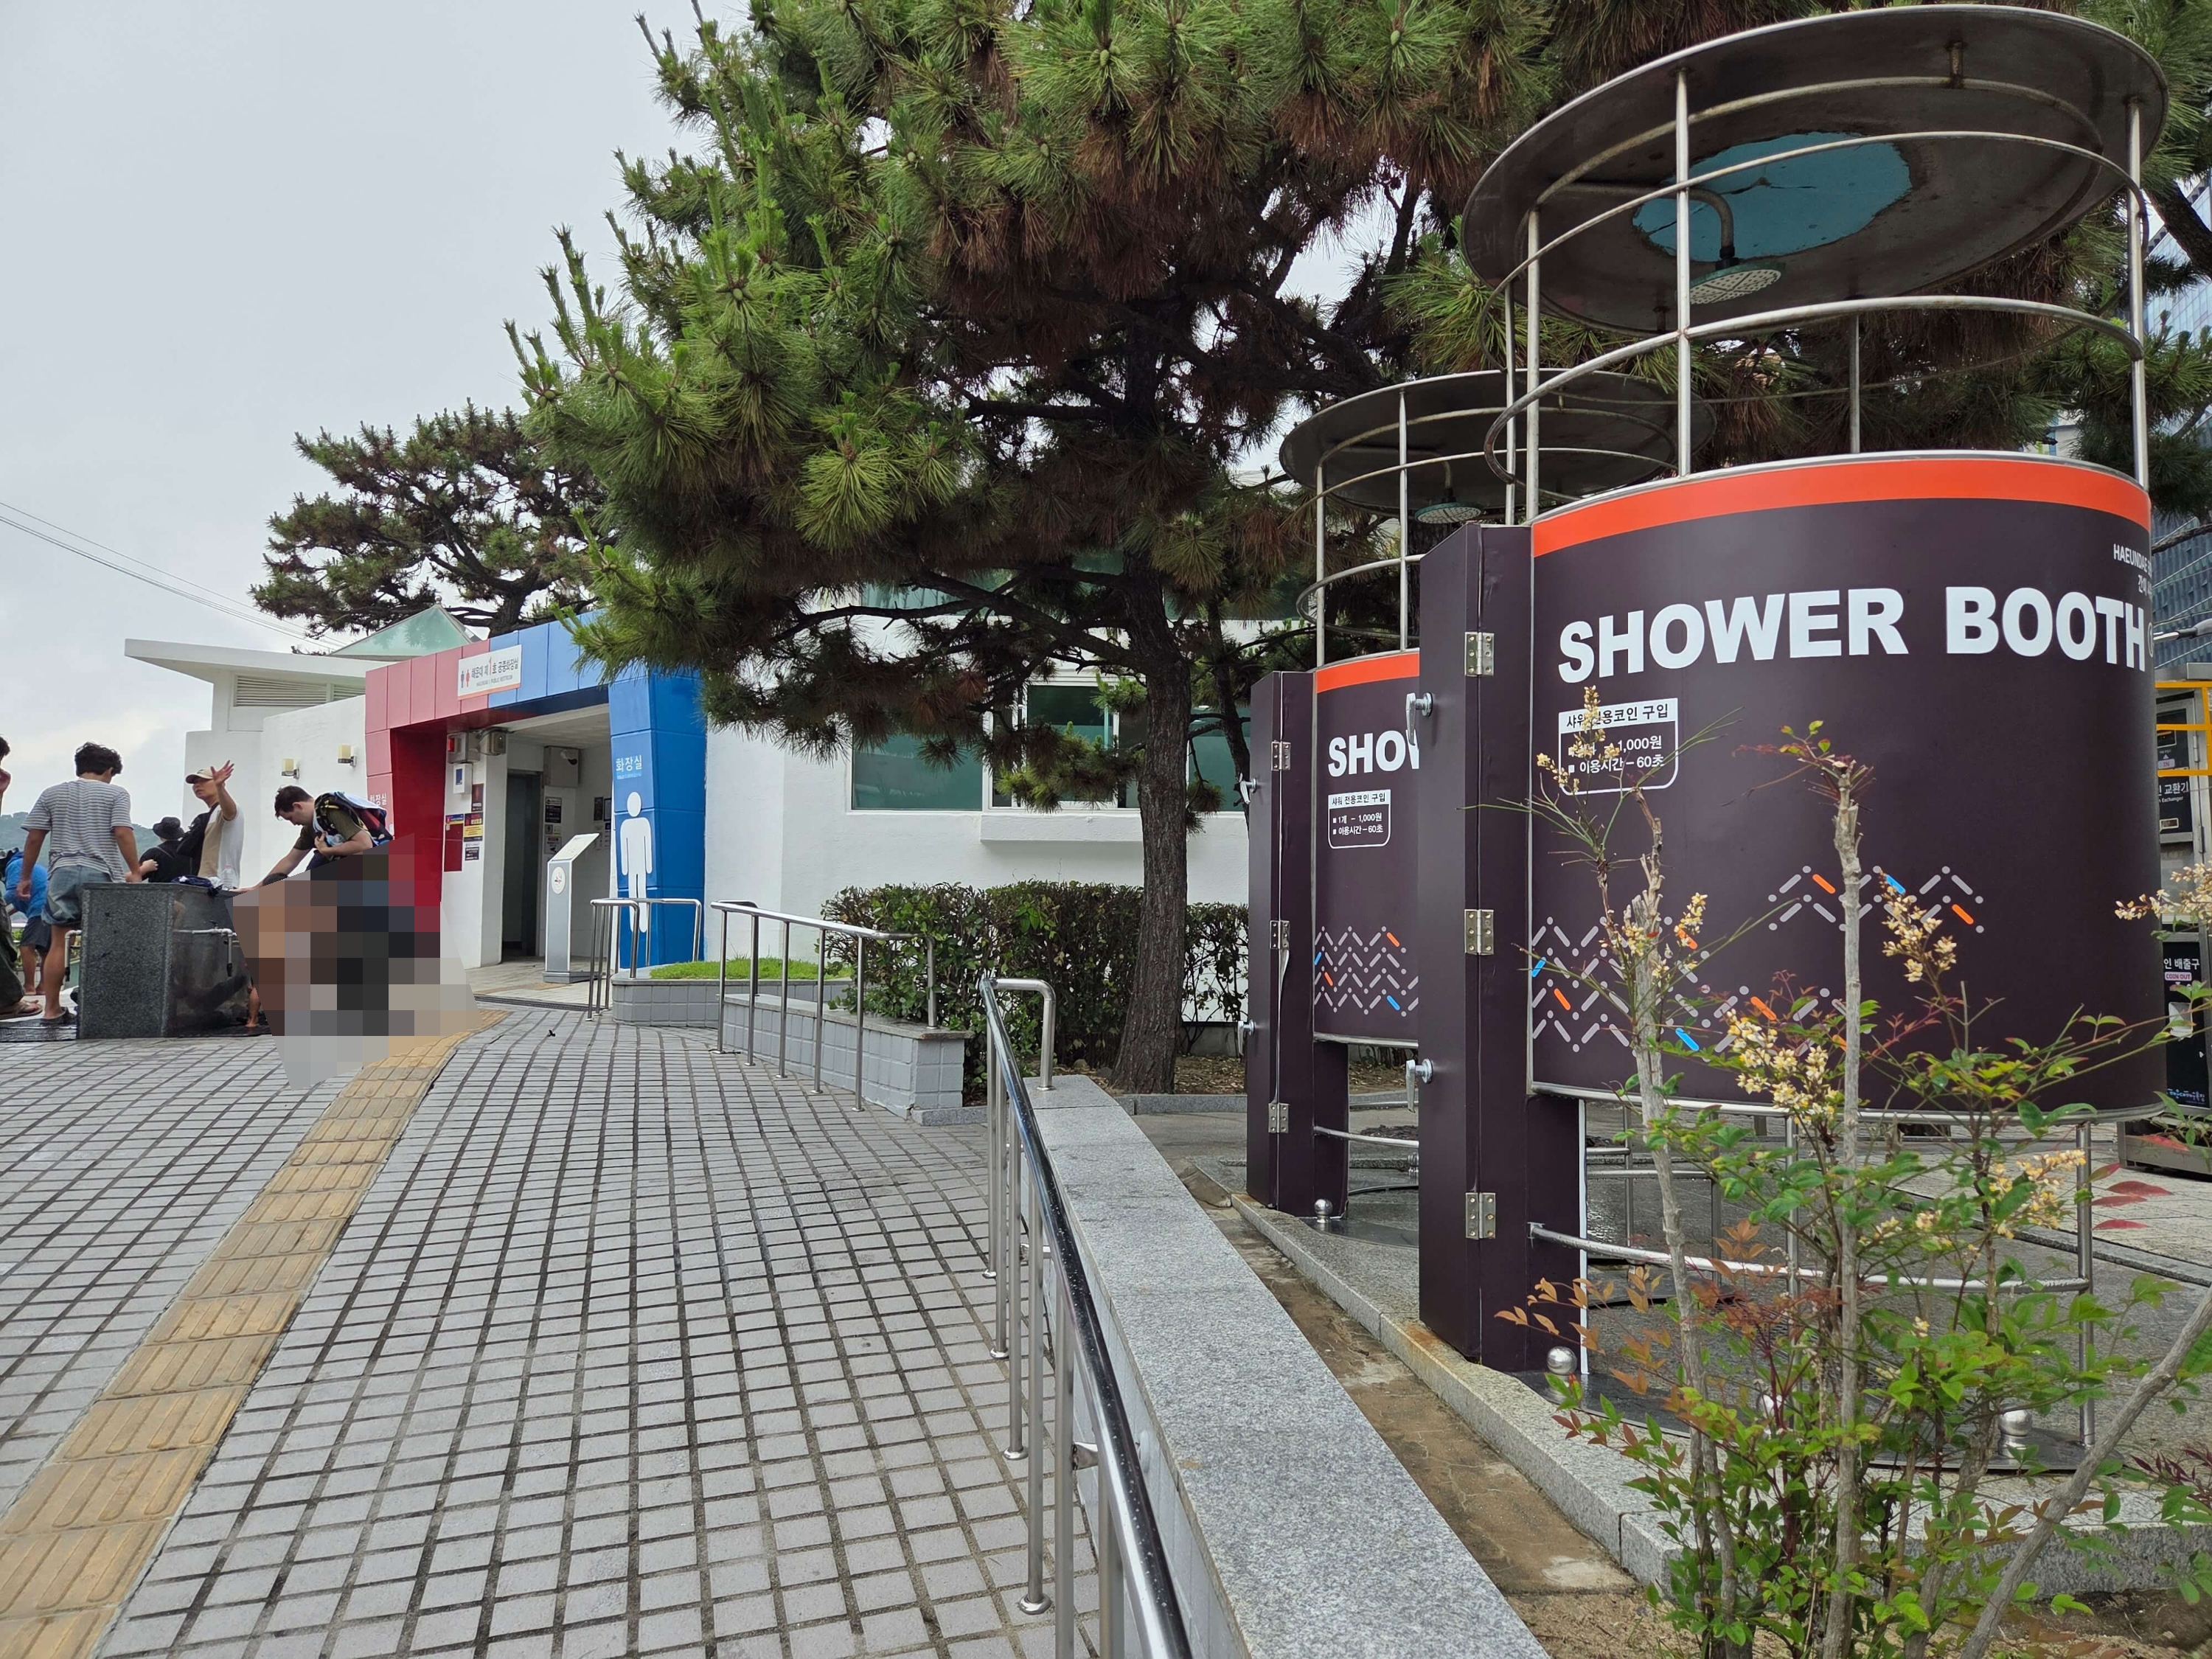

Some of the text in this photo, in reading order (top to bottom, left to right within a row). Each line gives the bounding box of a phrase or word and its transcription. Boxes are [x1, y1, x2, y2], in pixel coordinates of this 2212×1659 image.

[2113, 543, 2147, 573] HAEUNDAE
[1558, 586, 2145, 684] SHOWER BOOTH
[1643, 703, 1668, 720] 구입
[1618, 735, 1662, 754] 1,000원
[616, 754, 642, 773] 화장실
[1579, 758, 1623, 773] 이용시간
[1637, 754, 1664, 768] 60초
[2164, 781, 2189, 795] 교환기
[1332, 793, 1385, 806] 샤워 전용코인 구입
[1338, 815, 1347, 824] 1개
[1358, 813, 1382, 823] 1,000원
[1338, 825, 1362, 835] 이용시간
[1368, 824, 1384, 833] 60초
[2174, 958, 2200, 970] 배출구
